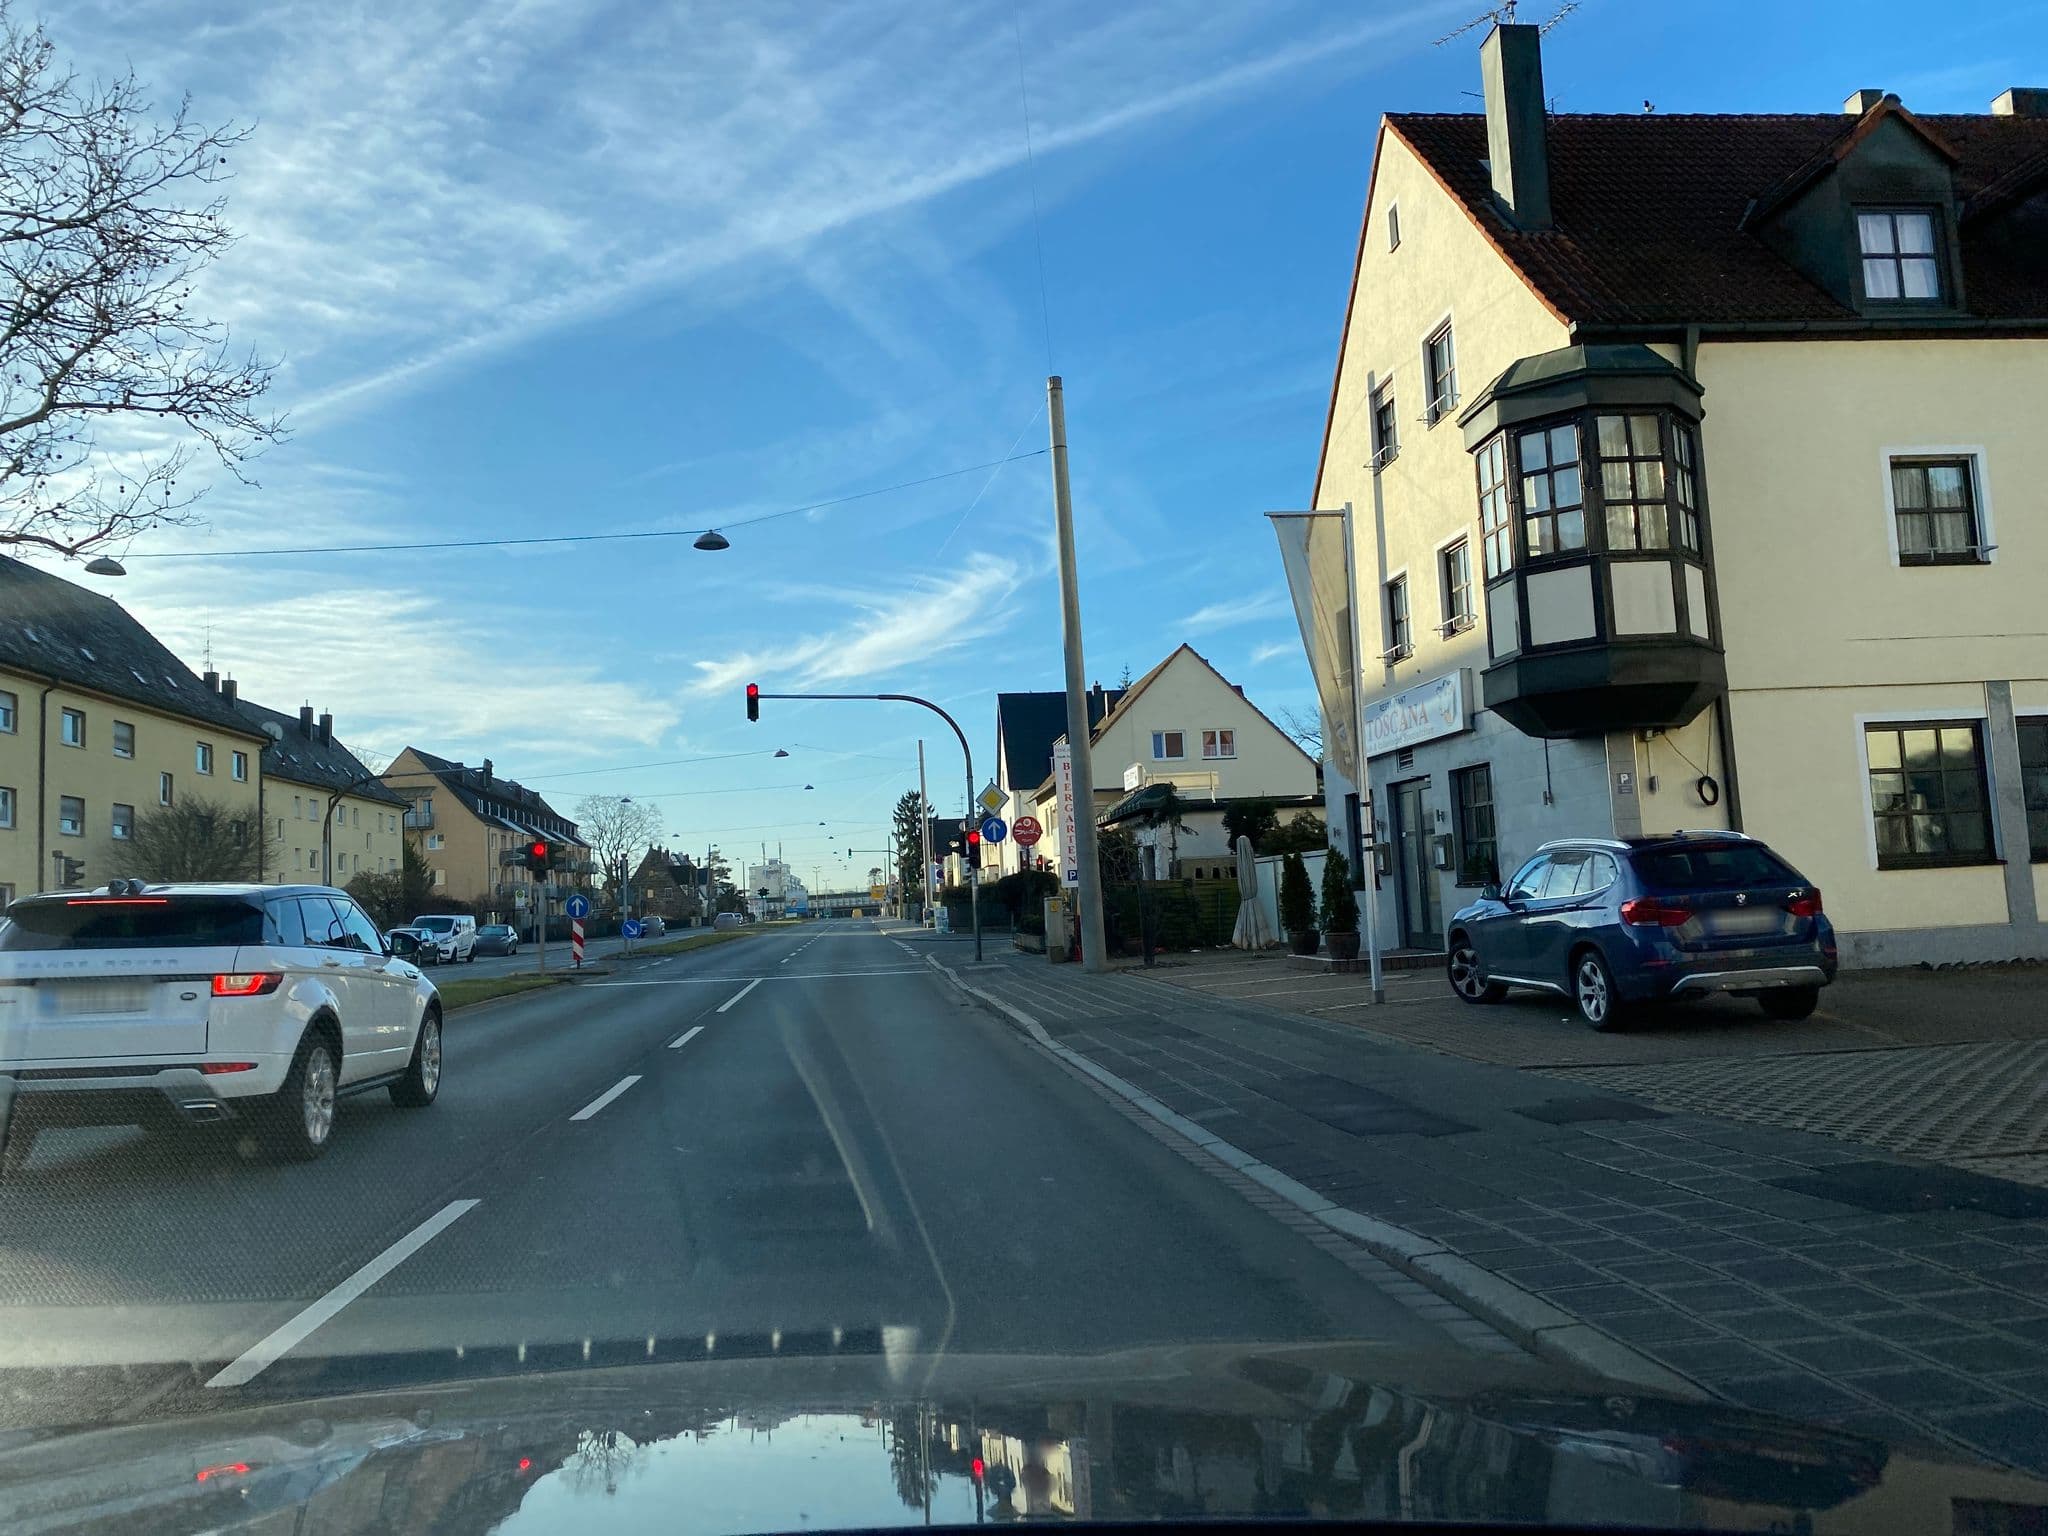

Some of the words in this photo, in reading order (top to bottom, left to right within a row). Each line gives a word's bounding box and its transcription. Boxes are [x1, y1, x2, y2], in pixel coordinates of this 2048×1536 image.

[1366, 702, 1429, 741] TOSCANA
[1620, 773, 1629, 784] P
[1063, 762, 1076, 865] BIERGARTEN
[1069, 871, 1077, 880] P
